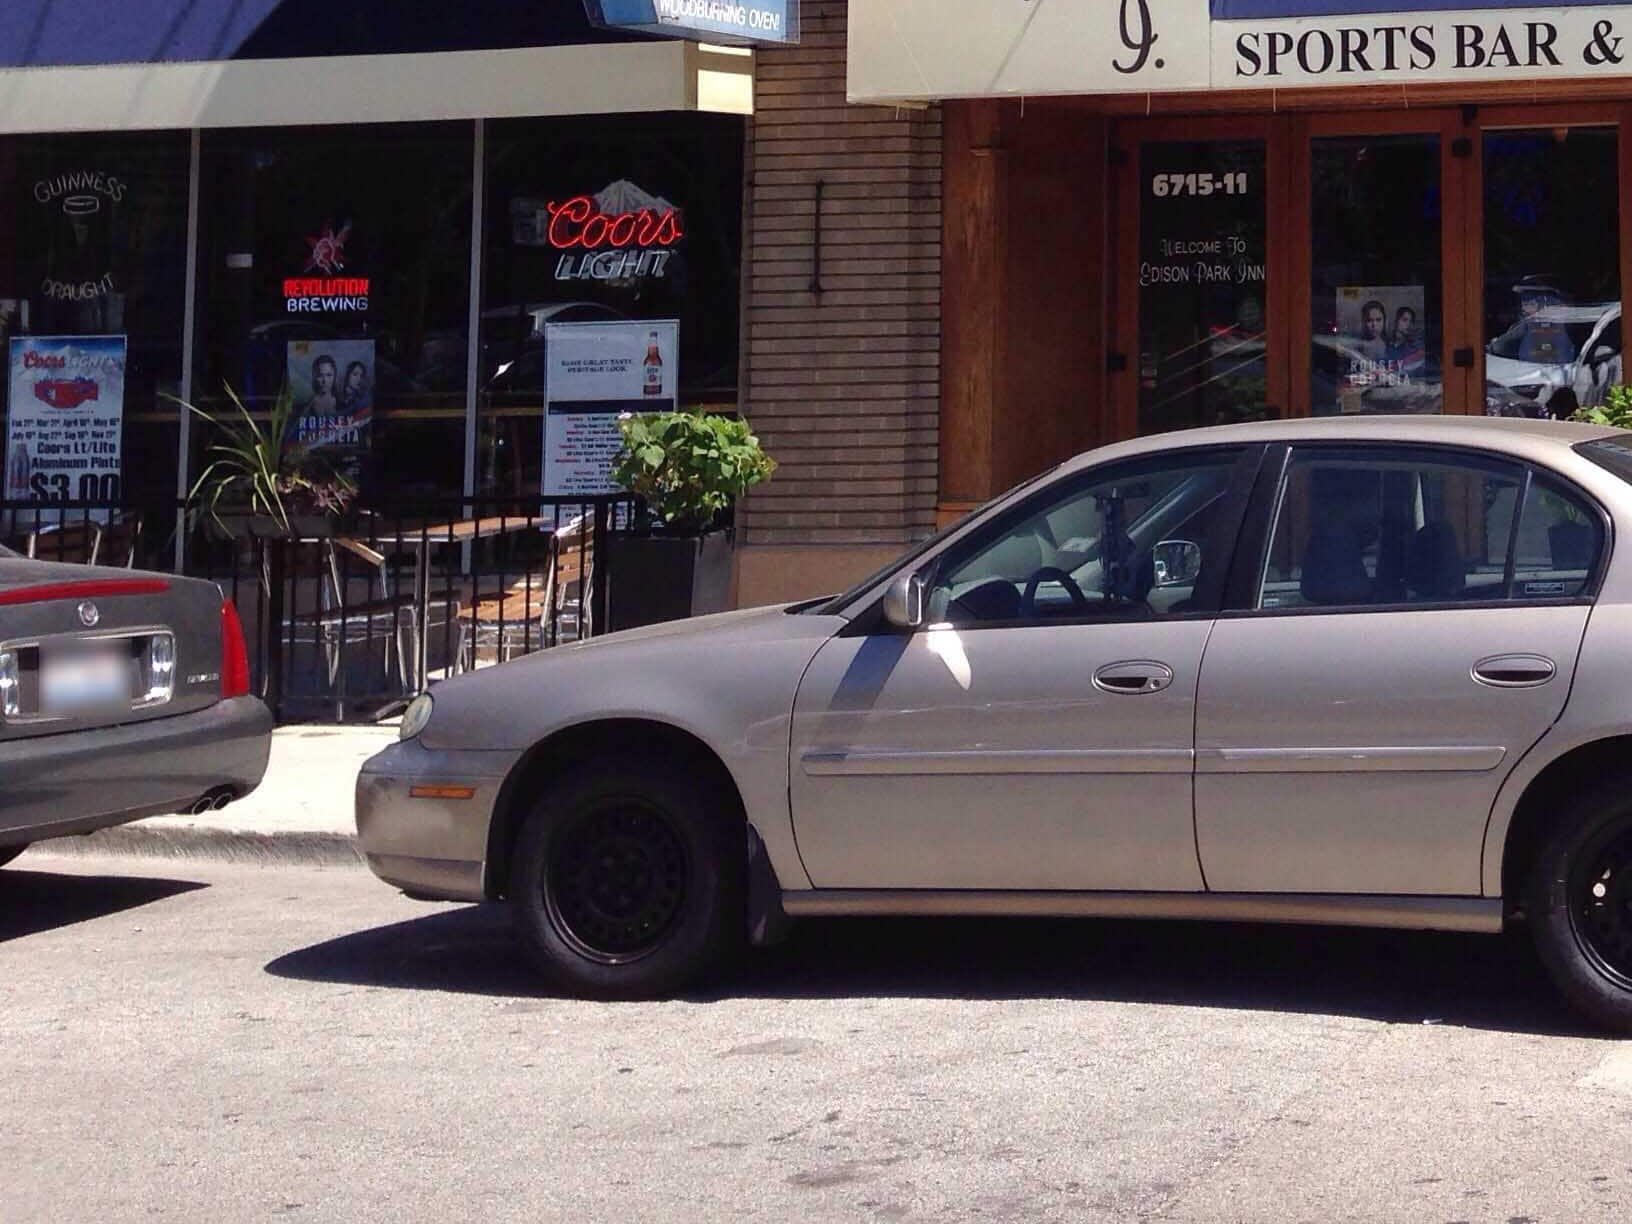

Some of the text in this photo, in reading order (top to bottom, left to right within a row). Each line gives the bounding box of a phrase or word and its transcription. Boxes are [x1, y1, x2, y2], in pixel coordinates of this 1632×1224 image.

[1235, 24, 1436, 76] SPORTS
[1451, 20, 1563, 68] BAR
[1582, 19, 1625, 65] &
[34, 171, 127, 203] GUINNESS
[1152, 173, 1247, 197] 6715-11
[547, 195, 683, 248] Coors
[555, 250, 670, 280] LIGHT
[41, 272, 113, 302] DRAUGHT
[282, 278, 369, 296] REVOLUTION
[287, 297, 369, 312] BREWING
[37, 442, 70, 455] Coors
[30, 471, 120, 501] $300
